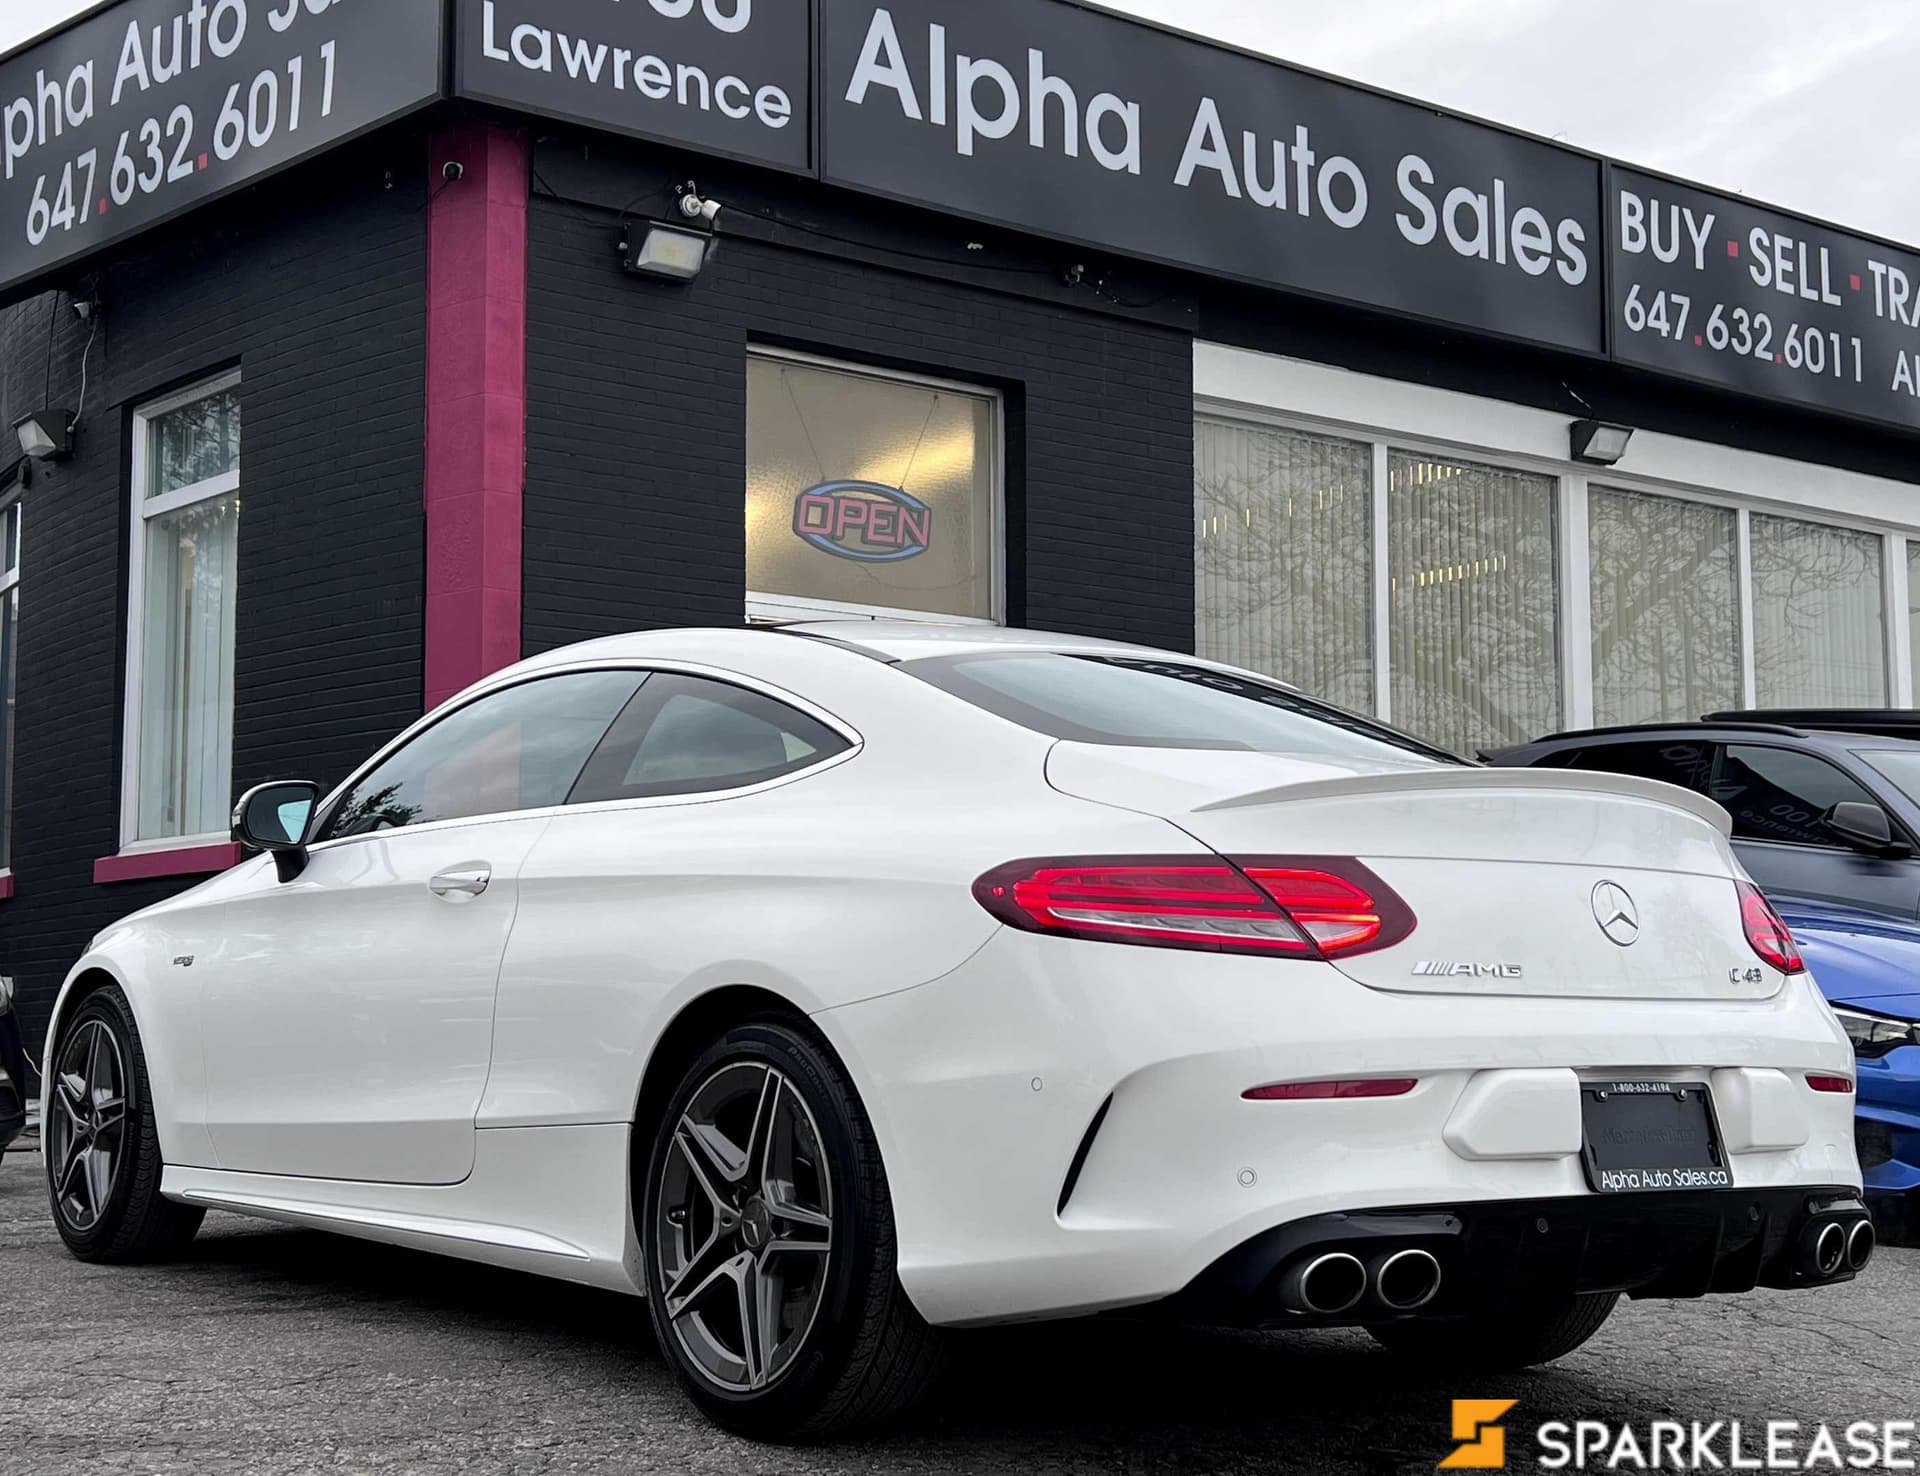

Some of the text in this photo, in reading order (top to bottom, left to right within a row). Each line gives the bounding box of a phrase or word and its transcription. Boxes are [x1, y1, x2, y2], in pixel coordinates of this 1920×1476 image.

[3, 0, 247, 179] pha Auto
[482, 0, 793, 129] Lawrence
[26, 39, 336, 247] 647.632.6011
[844, 7, 1589, 287] Alpha Auto Sales
[1620, 189, 1716, 271] BUY
[1748, 226, 1842, 306] SELL
[1623, 284, 1863, 383] 647.632.6011
[1891, 349, 1920, 398] A
[797, 493, 931, 548] OPEN
[1450, 961, 1523, 979] AMG
[1602, 1168, 1729, 1191] Alpha Auto Sales.ca
